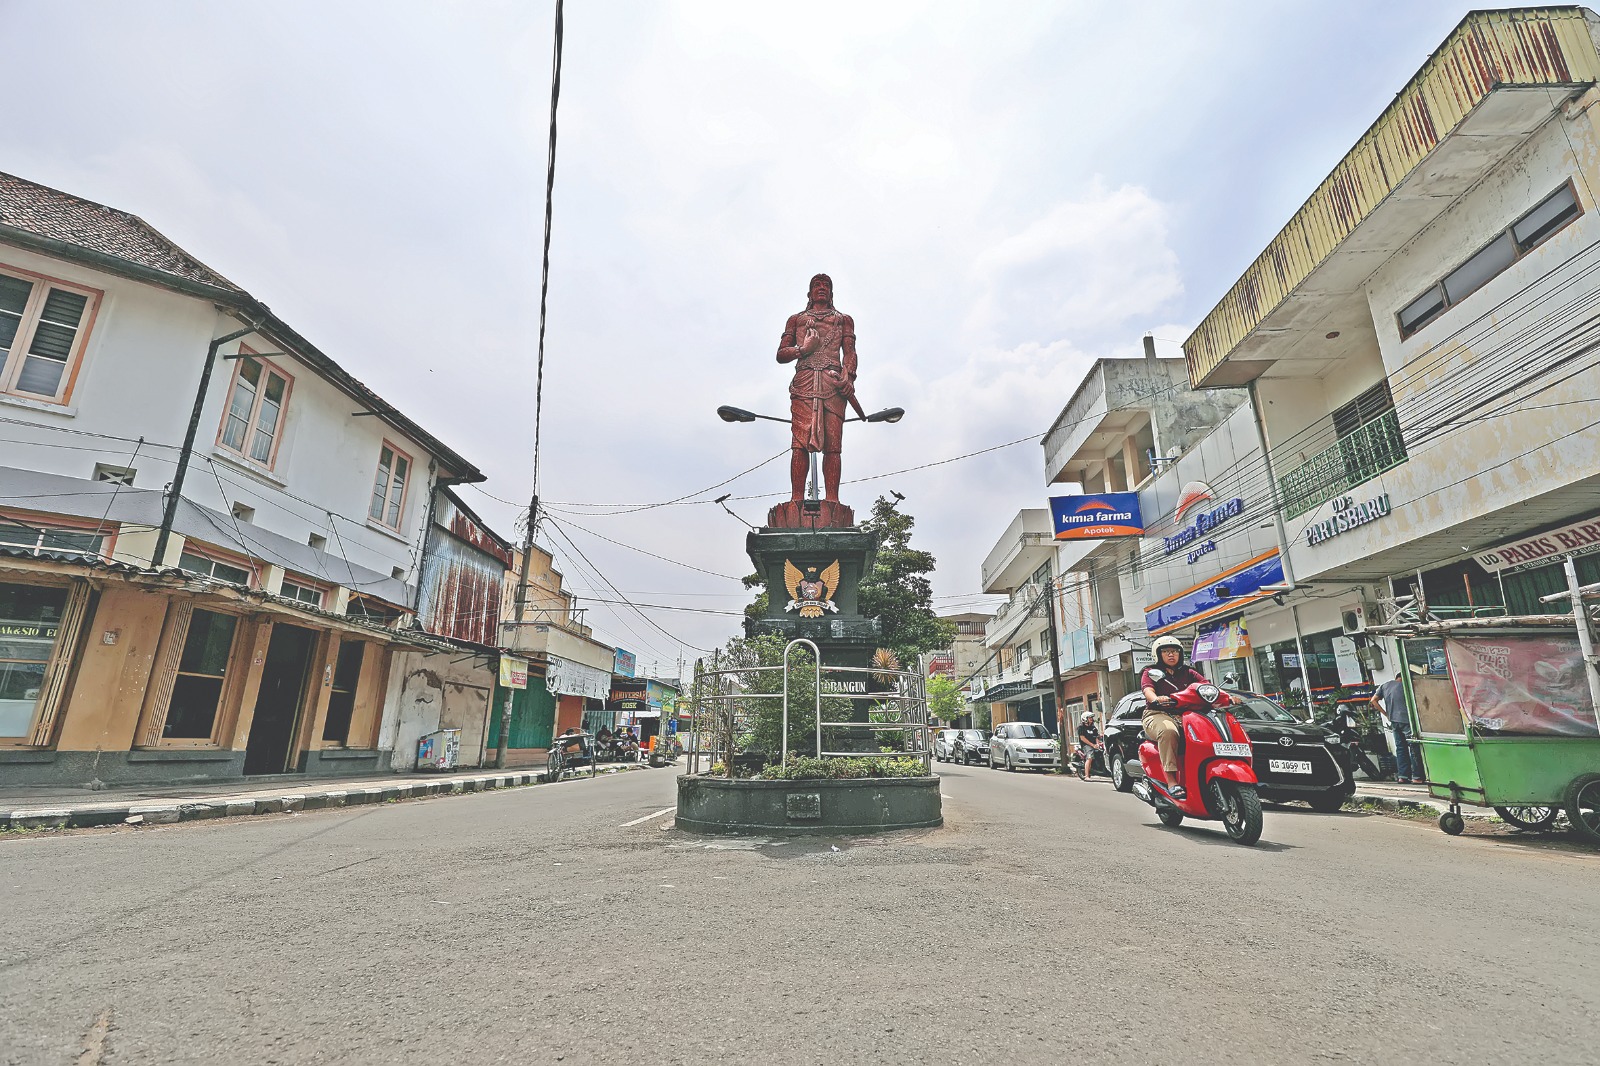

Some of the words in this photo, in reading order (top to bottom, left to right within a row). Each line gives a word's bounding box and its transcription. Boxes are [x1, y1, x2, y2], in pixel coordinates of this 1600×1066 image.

[1062, 514, 1094, 524] kimia
[1096, 511, 1132, 522] farma
[1083, 527, 1115, 536] Apotek
[1479, 553, 1504, 566] UD.
[1497, 536, 1560, 566] PARIS
